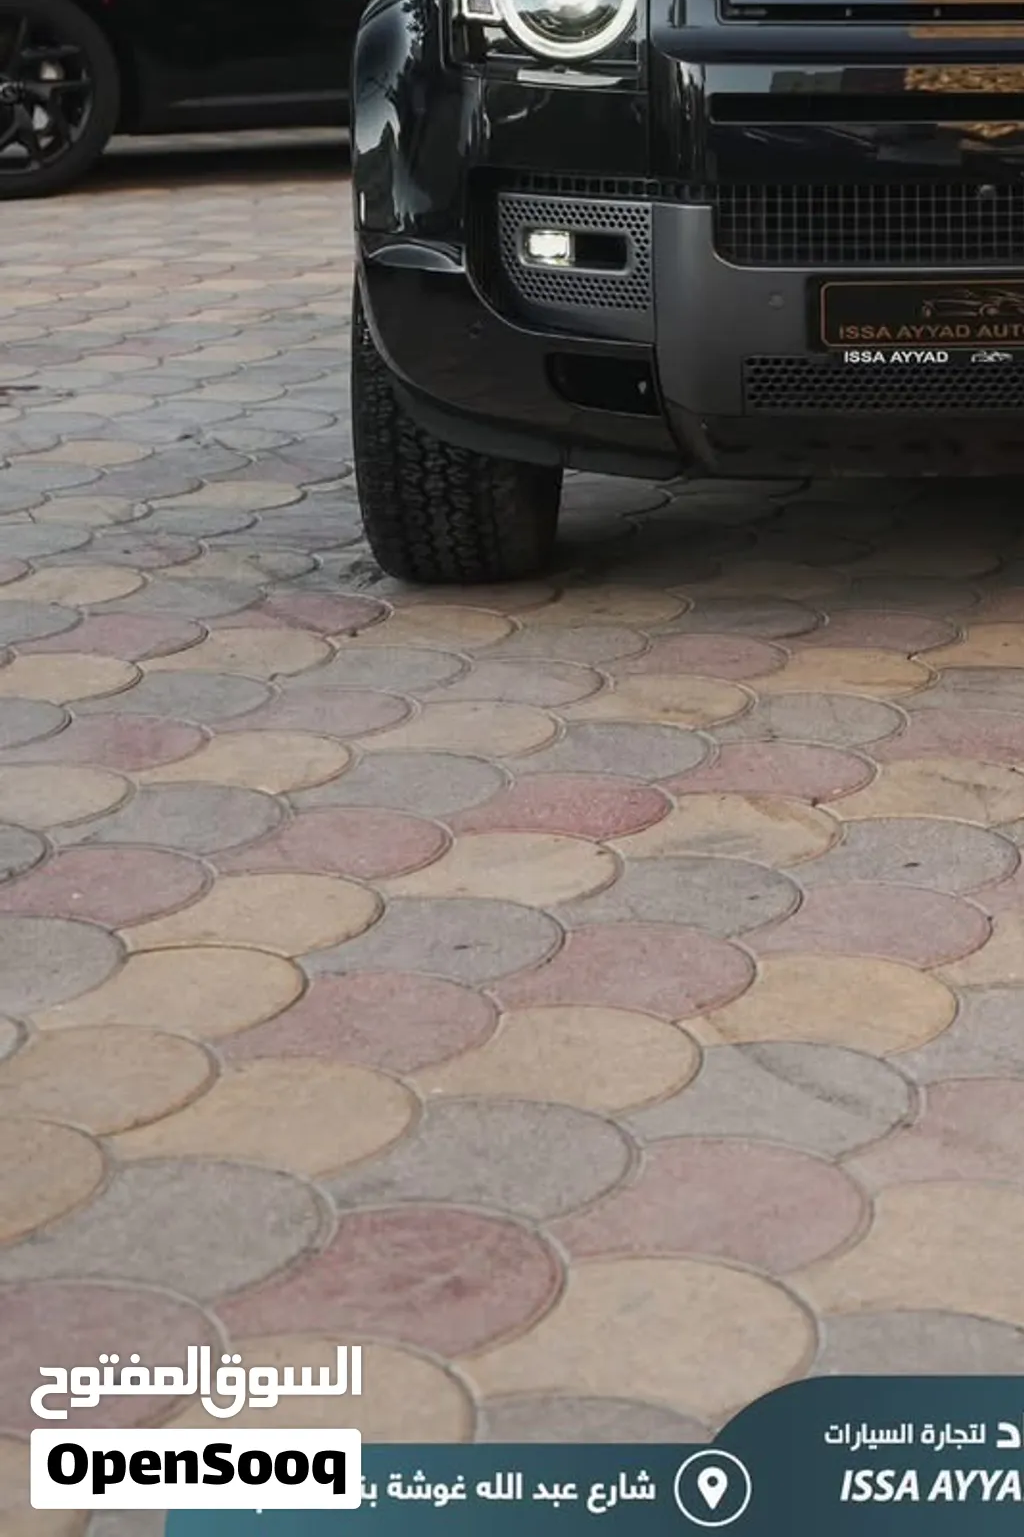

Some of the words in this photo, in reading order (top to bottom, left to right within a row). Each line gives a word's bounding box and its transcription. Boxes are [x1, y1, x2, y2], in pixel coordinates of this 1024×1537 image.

[839, 325, 892, 340] ISSA
[897, 324, 971, 339] AYYAD
[844, 350, 886, 363] ISSA
[889, 350, 949, 363] AYYAD
